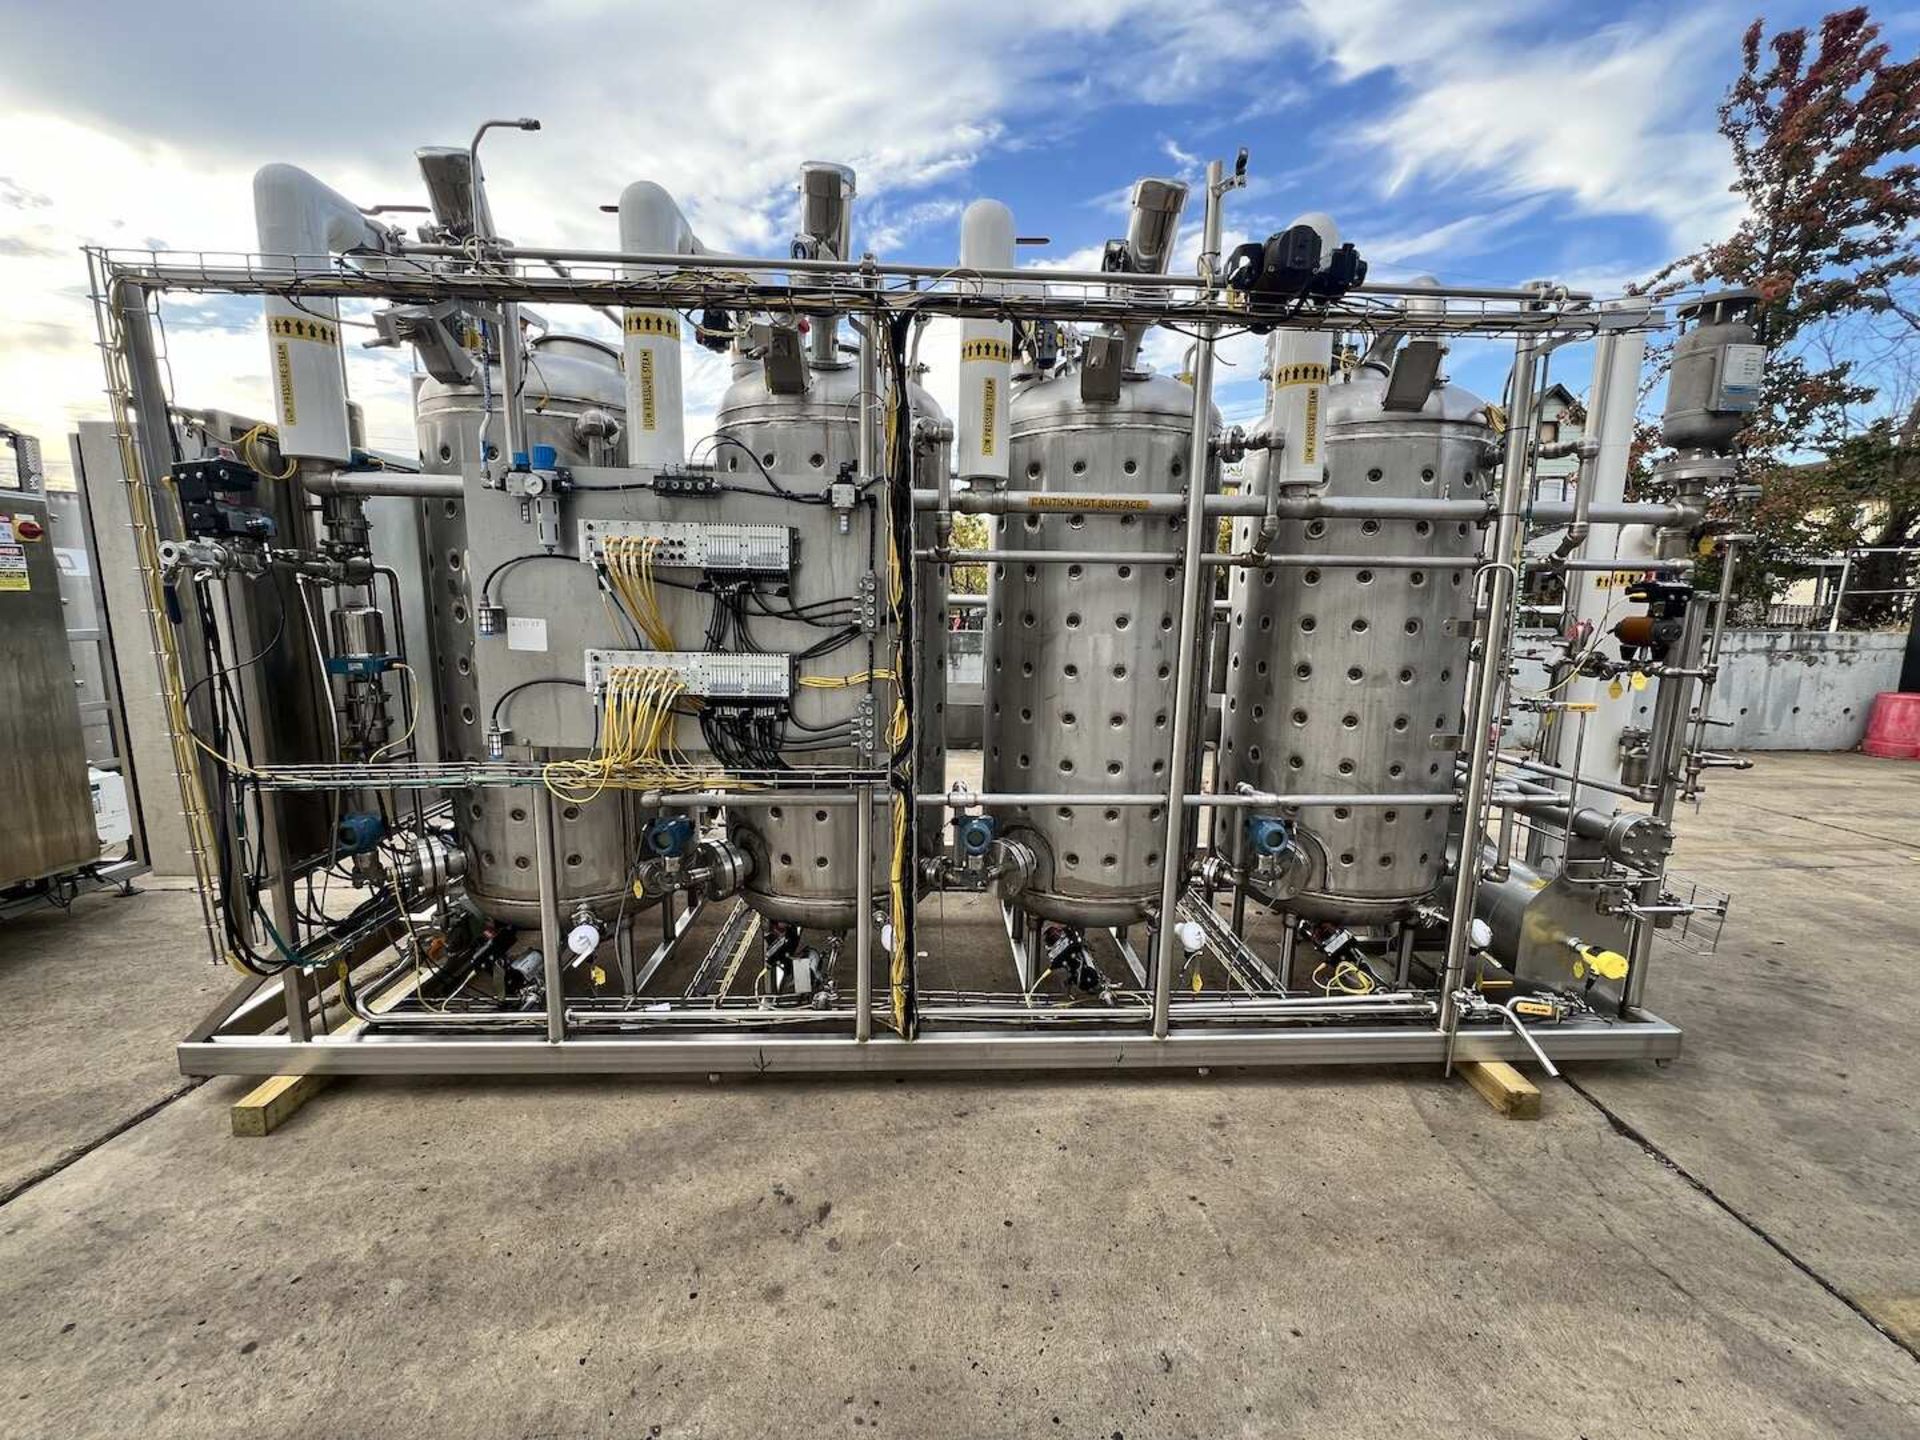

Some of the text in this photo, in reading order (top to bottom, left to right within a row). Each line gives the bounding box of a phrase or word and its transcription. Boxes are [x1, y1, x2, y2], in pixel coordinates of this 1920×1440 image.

[277, 345, 288, 369] STEAM
[640, 351, 651, 373] STEAM
[983, 380, 994, 455] LOW PRESSURE STEAM
[1304, 447, 1314, 462] LOW
[1031, 497, 1143, 510] CAUTION HOT SURFACE
